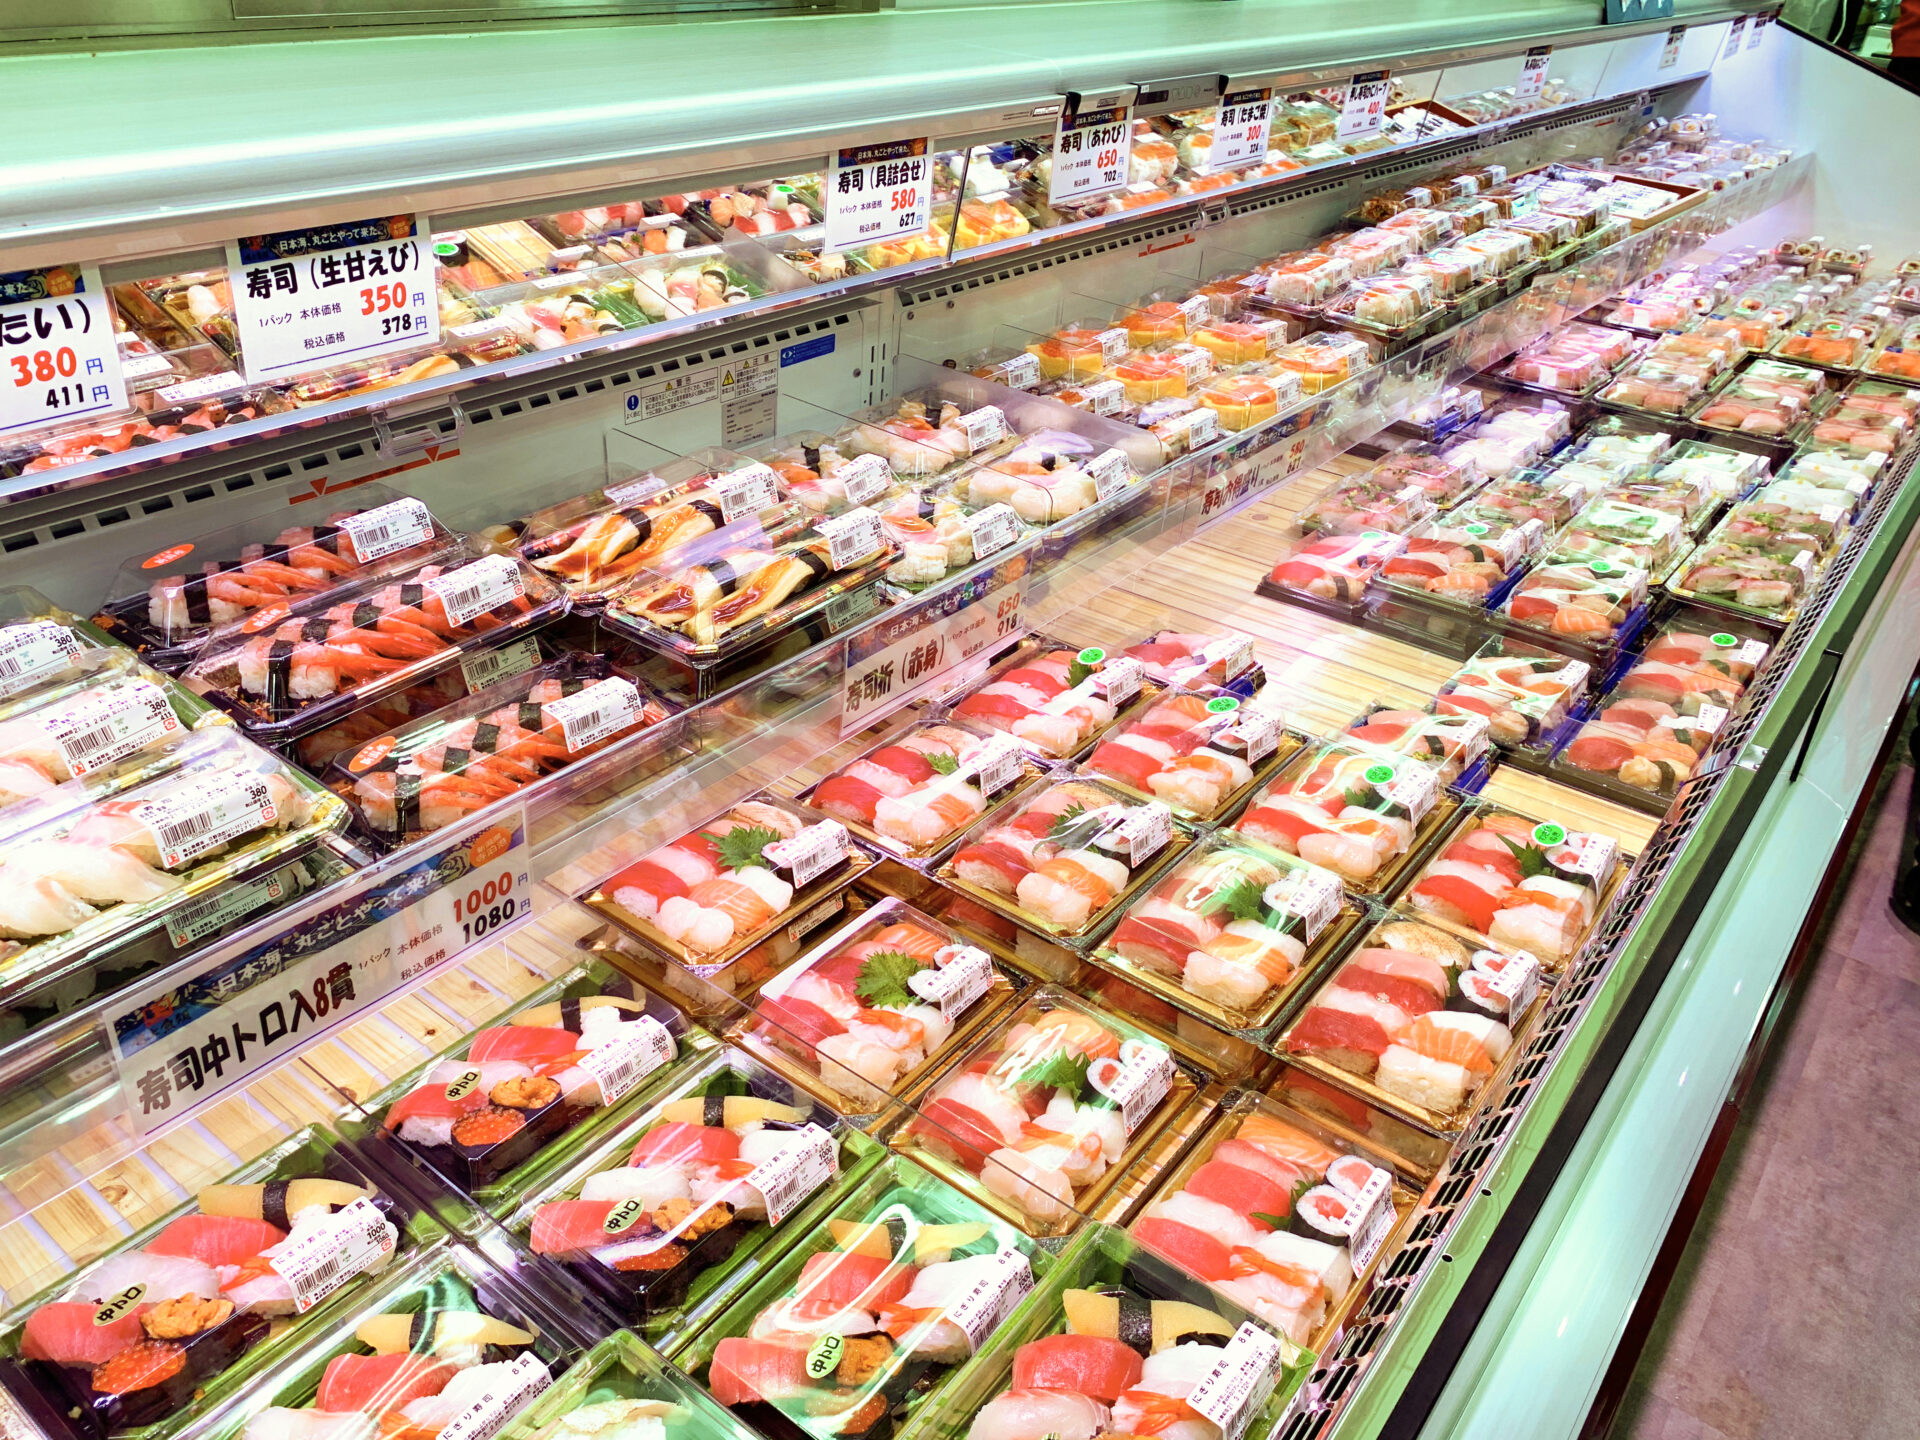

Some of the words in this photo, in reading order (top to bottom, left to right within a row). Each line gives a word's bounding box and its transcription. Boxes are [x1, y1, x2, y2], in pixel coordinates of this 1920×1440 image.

[1060, 123, 1126, 154] 寿司（あわび）
[1246, 124, 1261, 141] 300
[1097, 149, 1117, 168] 650
[838, 158, 926, 194] 寿司（貝詰合せ）
[1104, 170, 1117, 182] 702
[860, 200, 882, 210] 本体価格
[891, 188, 915, 211] 580
[918, 197, 924, 208] 円
[860, 222, 881, 233] 税込価格
[899, 212, 915, 227] 627
[916, 215, 923, 225] 円
[246, 241, 419, 299] 寿司（生甘えび）
[259, 312, 292, 327] 1パック
[300, 302, 341, 320] 本体価格
[360, 282, 407, 315] 350
[412, 292, 425, 307] 円
[304, 332, 345, 350] 税込価格
[382, 314, 411, 335] 378
[415, 316, 427, 330] 円
[10, 347, 77, 387] 380
[86, 358, 103, 375] 円
[46, 384, 84, 408] 411
[92, 385, 109, 402] 円
[1289, 440, 1305, 458] 580
[415, 512, 427, 522] 350
[505, 568, 518, 579] 350
[997, 592, 1020, 620] 850
[997, 613, 1017, 637] 918
[55, 635, 72, 647] 380
[523, 639, 535, 648] 350
[846, 634, 945, 713] 寿司折（赤身）
[150, 700, 167, 713] 380
[626, 694, 637, 704] 350
[160, 711, 172, 720] 411
[250, 785, 267, 799] 380
[259, 799, 271, 808] 411
[358, 947, 391, 970] 1パック
[397, 924, 443, 956] 本体価格
[453, 872, 513, 923] 1000
[518, 872, 528, 886] 円
[400, 948, 446, 981] 税込価格
[463, 898, 515, 944] 1080
[520, 898, 531, 911] 円
[136, 961, 356, 1115] 寿司中トロ入8貫
[652, 1035, 666, 1048] 1000
[447, 1071, 478, 1098] 中トロ
[820, 1146, 832, 1160] 1000
[607, 1199, 639, 1230] 中トロ
[367, 1222, 386, 1239] 1000
[96, 1287, 142, 1321] 中トロ
[954, 1280, 988, 1318] にぎり寿司
[811, 1336, 840, 1373] 中トロ
[1192, 1360, 1229, 1403] にぎり寿司
[1238, 1328, 1254, 1343] 8貫
[443, 1394, 493, 1440] にぎり寿司
[512, 1358, 530, 1375] 8貫
